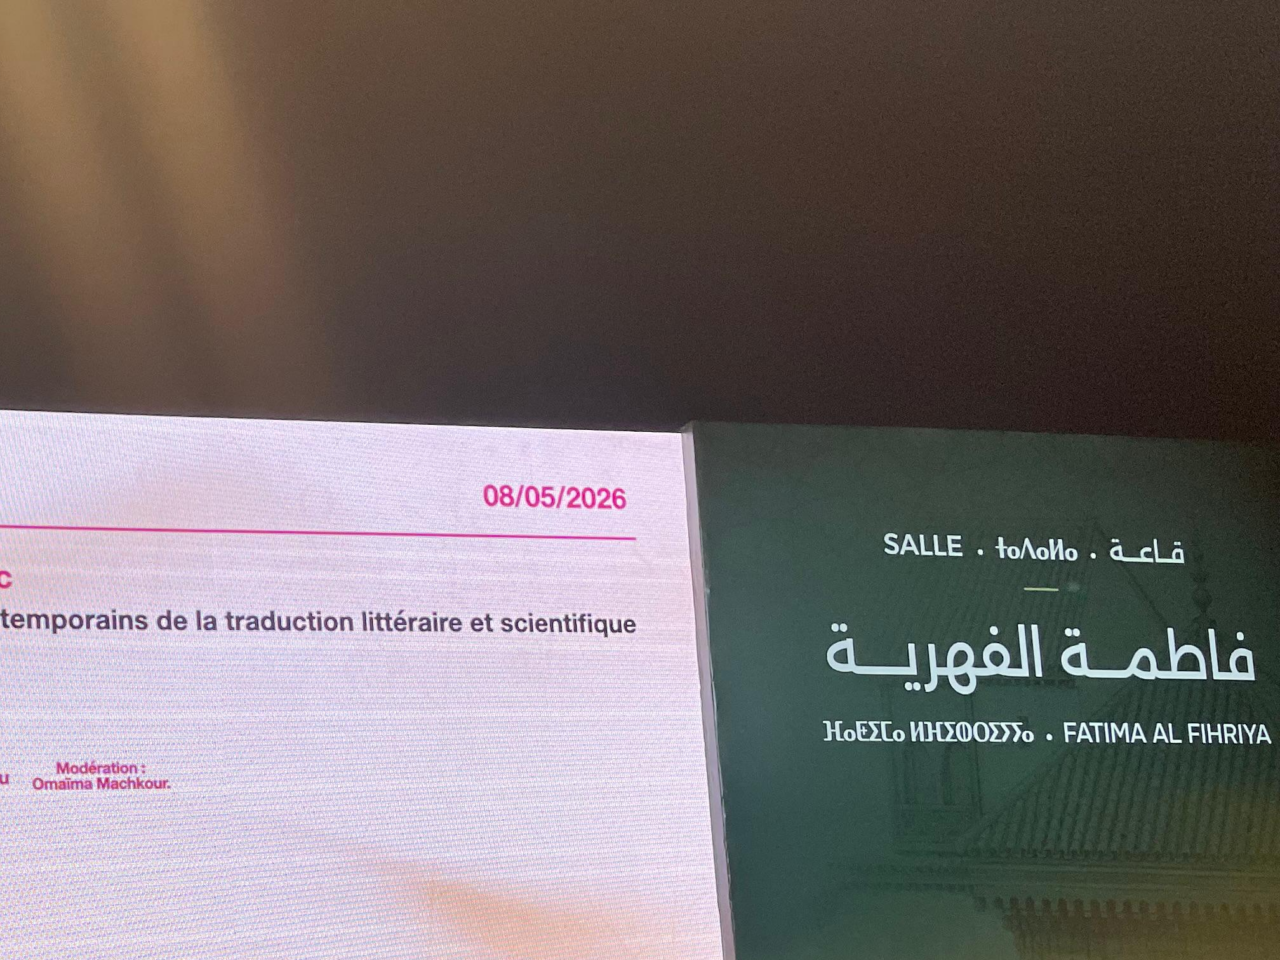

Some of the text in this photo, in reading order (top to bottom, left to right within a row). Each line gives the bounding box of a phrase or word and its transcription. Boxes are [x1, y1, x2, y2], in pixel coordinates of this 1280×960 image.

[483, 484, 626, 510] 08/05/2026
[883, 533, 963, 557] SALLE
[1110, 538, 1185, 564] قاعة
[157, 610, 187, 631] de
[196, 610, 218, 631] la
[225, 610, 354, 632] traduction
[362, 610, 463, 633] littéraire
[471, 613, 494, 633] et
[501, 612, 637, 638] scientifique
[826, 623, 1255, 695] فاطمة الفهرية
[1064, 721, 1146, 744] FATIMA
[1152, 722, 1181, 744] AL
[1188, 723, 1272, 745] FIHRIYA
[56, 761, 138, 774] Modération
[32, 777, 171, 790] Omaïma Machkour.
